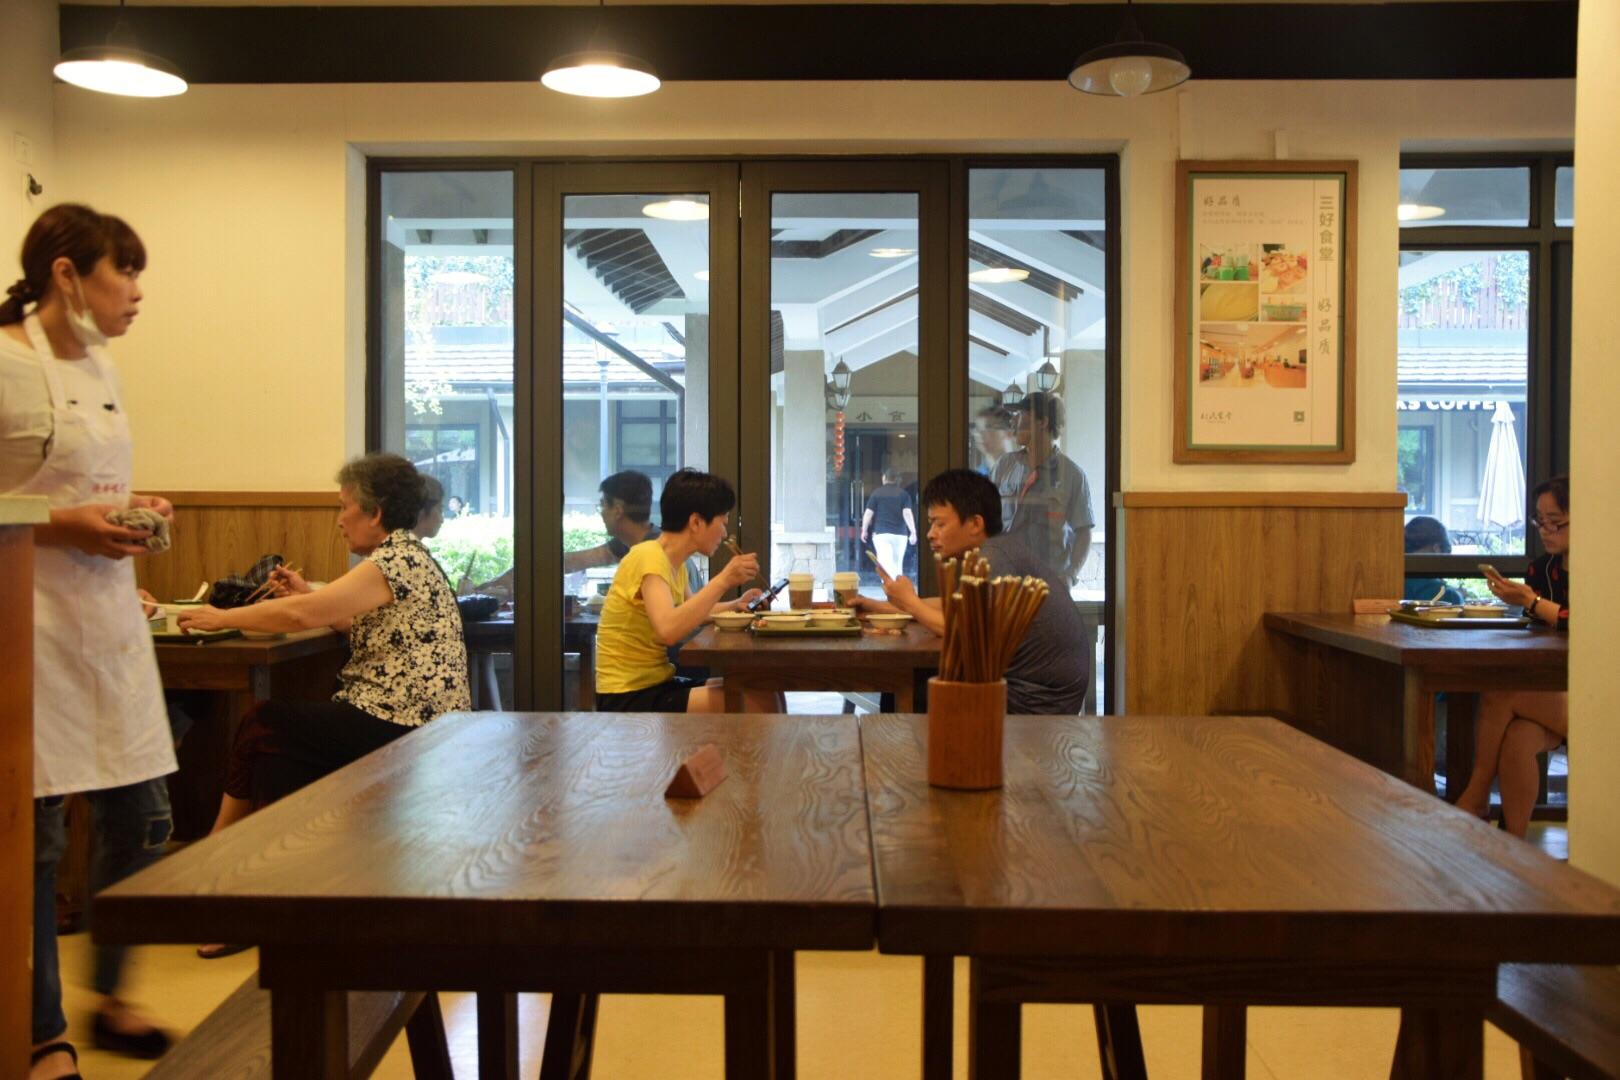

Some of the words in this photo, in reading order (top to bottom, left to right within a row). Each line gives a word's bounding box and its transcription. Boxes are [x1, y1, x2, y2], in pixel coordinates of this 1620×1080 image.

[1319, 196, 1334, 261] 三好食堂
[1318, 298, 1332, 354] 好品质
[1425, 399, 1496, 411] COFFE
